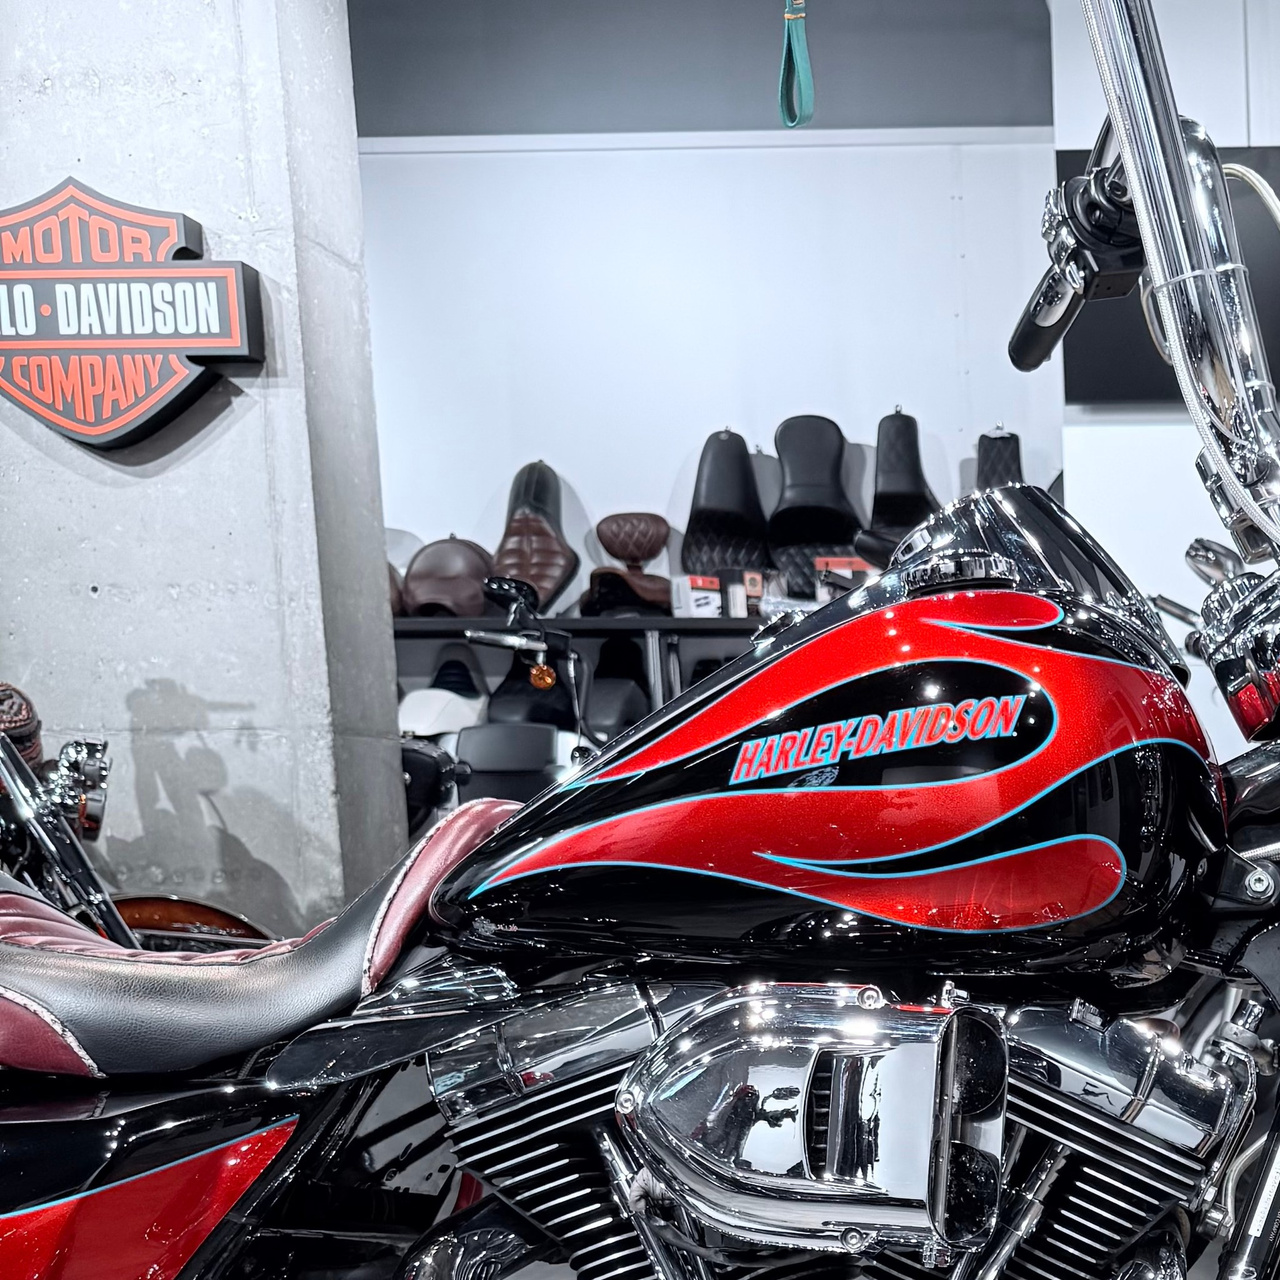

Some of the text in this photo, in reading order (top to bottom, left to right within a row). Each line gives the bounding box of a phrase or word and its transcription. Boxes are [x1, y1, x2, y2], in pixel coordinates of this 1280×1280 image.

[1, 203, 153, 263] MOTOR
[55, 282, 220, 335] DAVIDSON
[12, 354, 164, 422] COMPANY
[729, 695, 1027, 785] HARLEY-DAVIDSON
